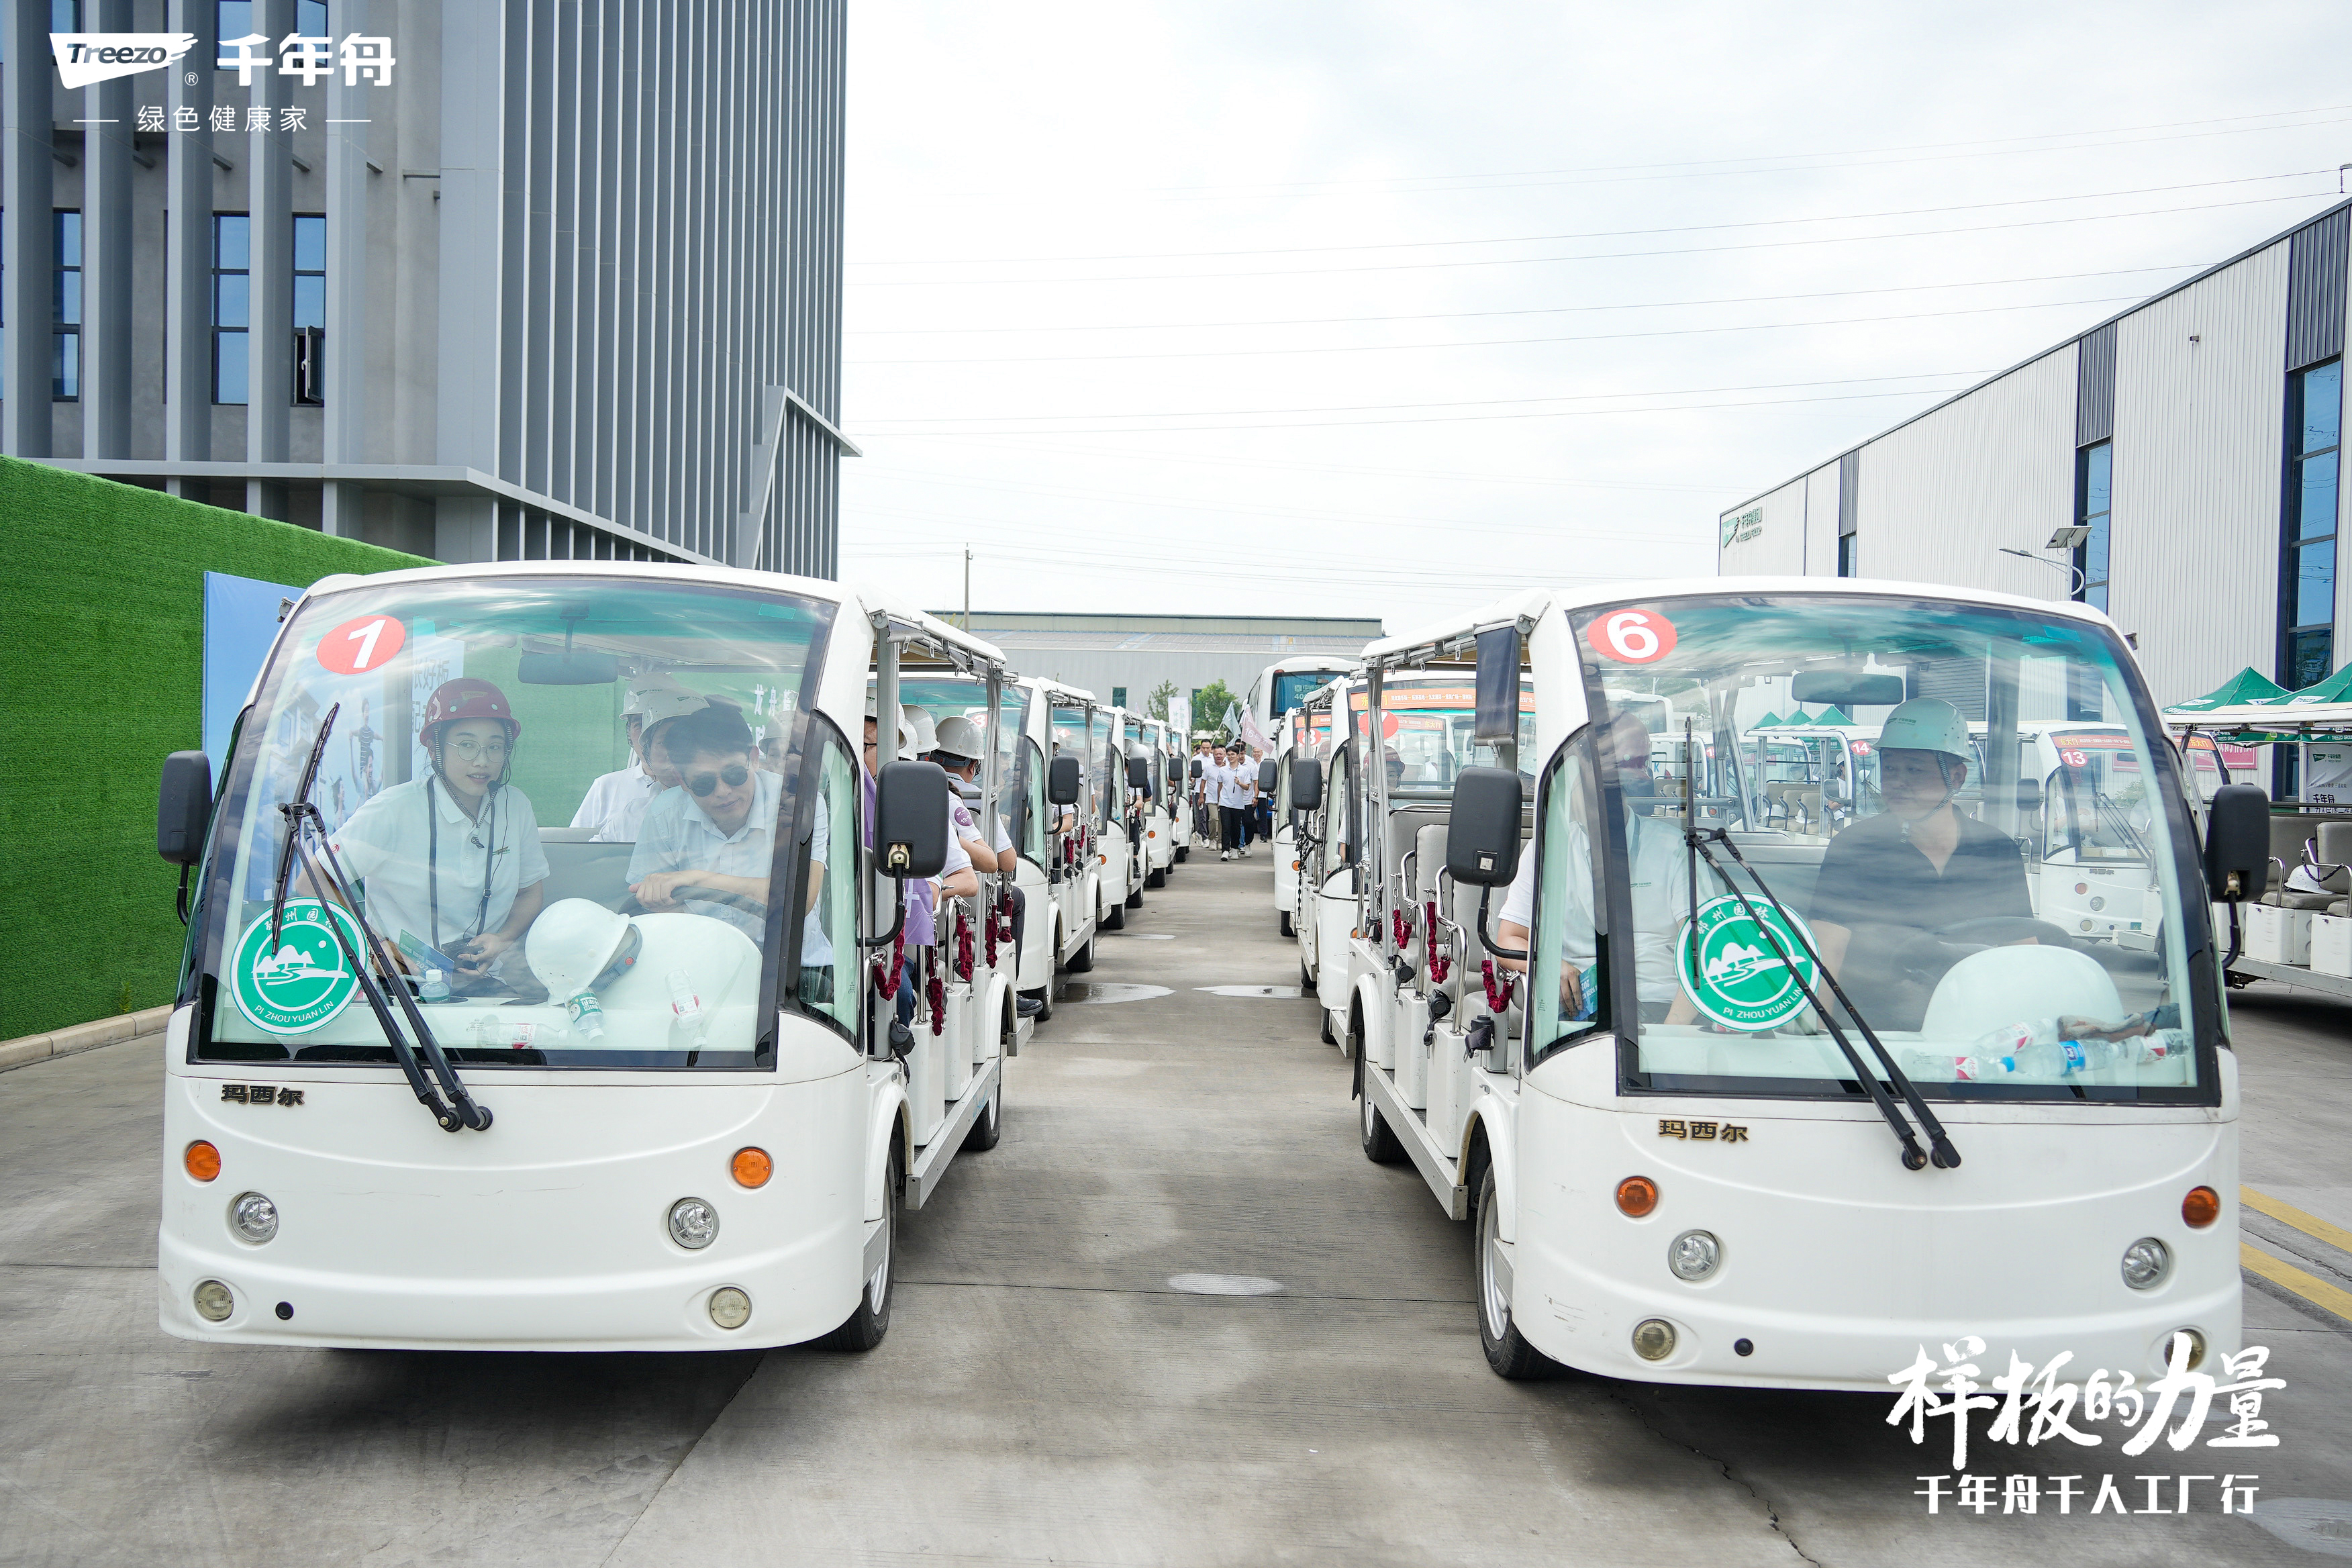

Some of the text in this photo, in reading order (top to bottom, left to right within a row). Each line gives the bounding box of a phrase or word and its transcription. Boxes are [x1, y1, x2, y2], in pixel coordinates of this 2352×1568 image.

[1606, 612, 1659, 659] 6
[347, 619, 386, 669] 1
[1361, 694, 1388, 707] 东门
[973, 714, 985, 726] 3
[1301, 718, 1318, 726] 东门
[1852, 742, 1870, 753] 14
[2059, 738, 2080, 746] 东大门
[2190, 738, 2209, 748] 东大门
[2063, 751, 2086, 765] 13
[2312, 793, 2335, 803] 千年舟
[1722, 985, 1804, 1019] PI ZHOU YUAN LIN
[254, 1000, 334, 1023] PI ZHOU YUAN LIN
[220, 1084, 305, 1108] 玛西尔
[1658, 1119, 1749, 1143] 玛西尔
